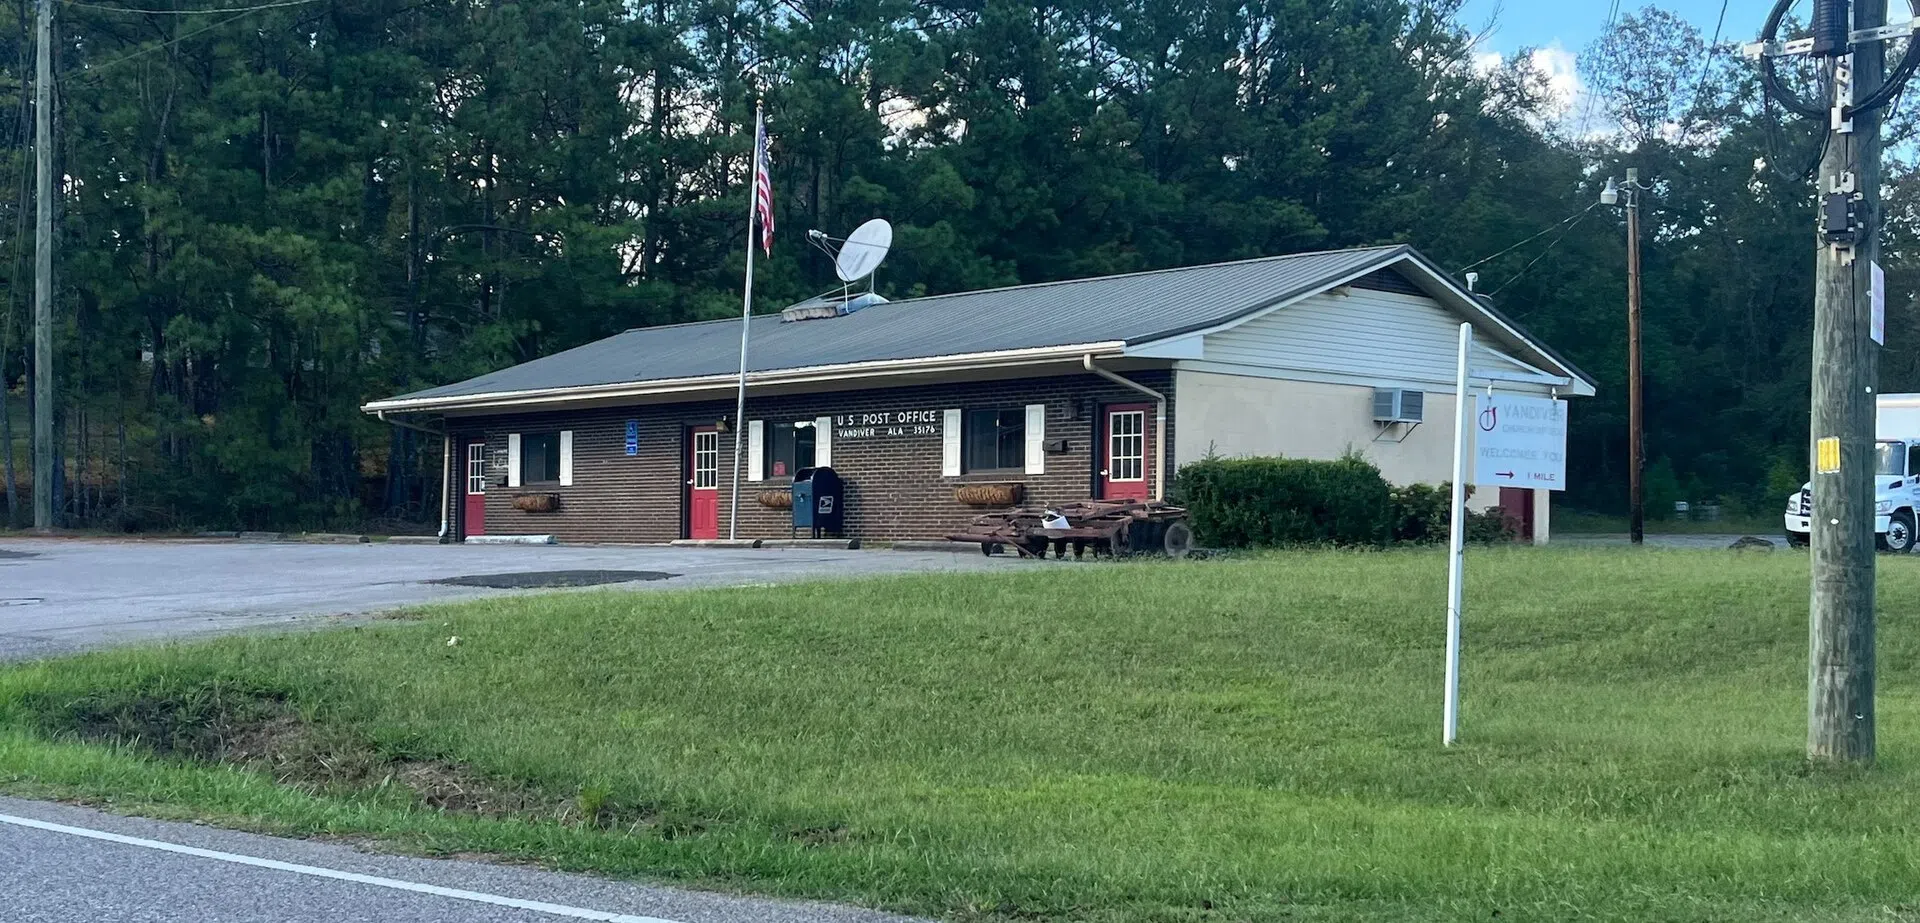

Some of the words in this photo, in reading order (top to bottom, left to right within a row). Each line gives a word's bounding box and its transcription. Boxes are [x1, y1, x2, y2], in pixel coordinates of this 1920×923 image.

[863, 412, 890, 425] POST
[897, 410, 936, 423] OFFICE
[838, 428, 875, 438] VANDIVER
[887, 427, 904, 436] ALA
[913, 425, 936, 434] 35176
[1533, 472, 1556, 481] MILE
